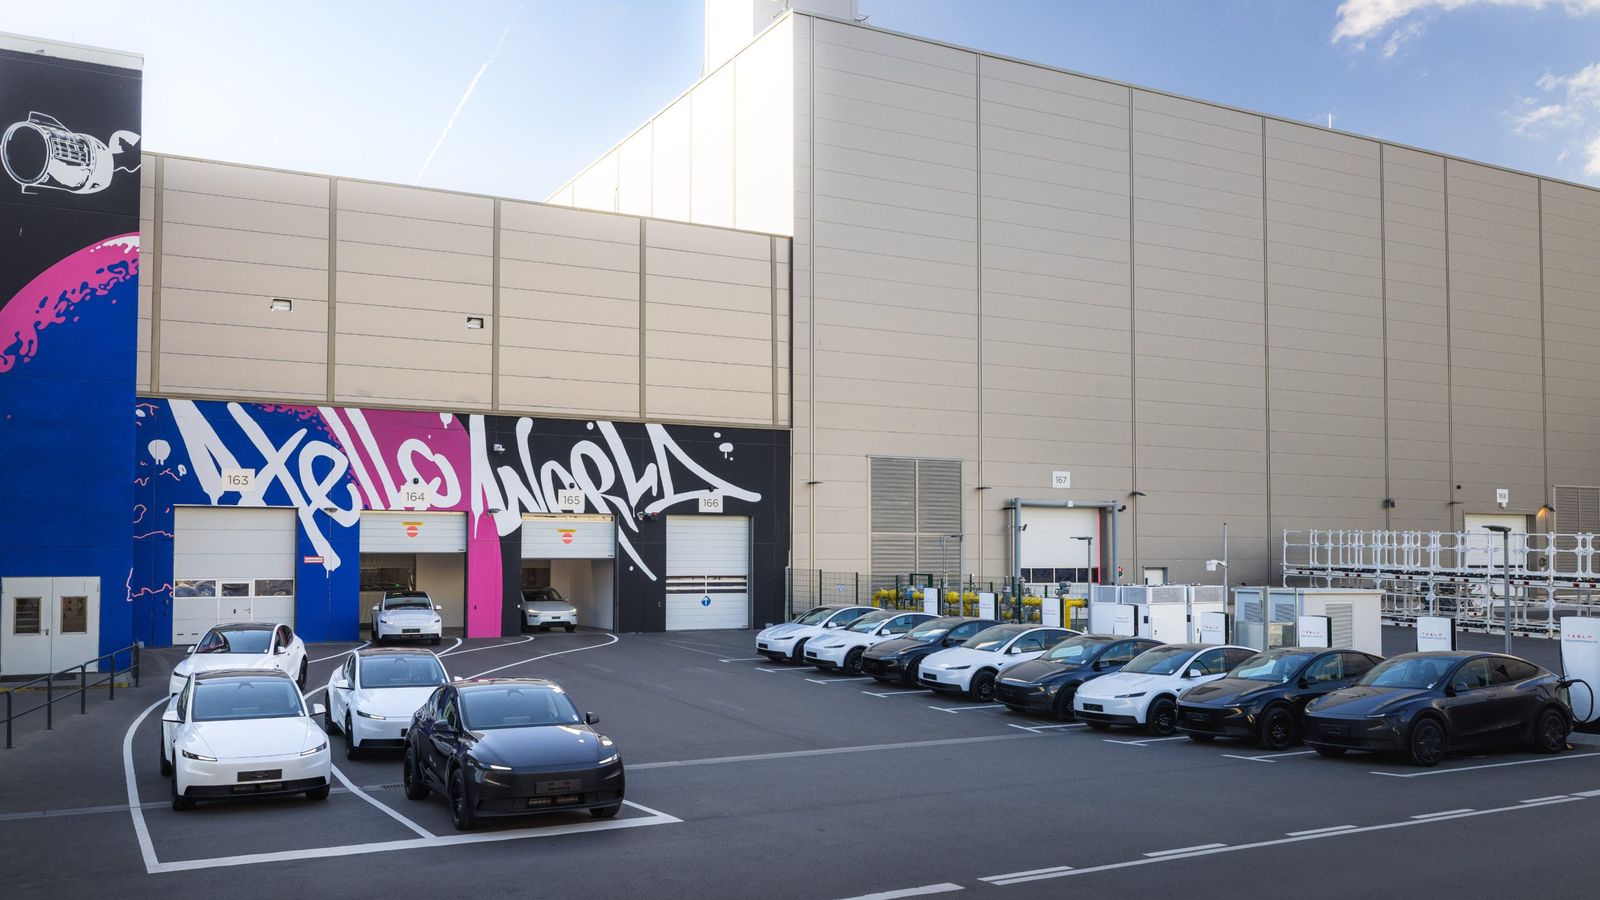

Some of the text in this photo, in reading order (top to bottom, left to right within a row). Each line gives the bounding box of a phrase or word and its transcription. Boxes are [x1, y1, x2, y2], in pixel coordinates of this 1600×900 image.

[227, 474, 249, 486] 163
[1055, 475, 1067, 484] 167
[405, 492, 425, 502] 164
[562, 495, 581, 505] 165
[703, 498, 719, 508] 166
